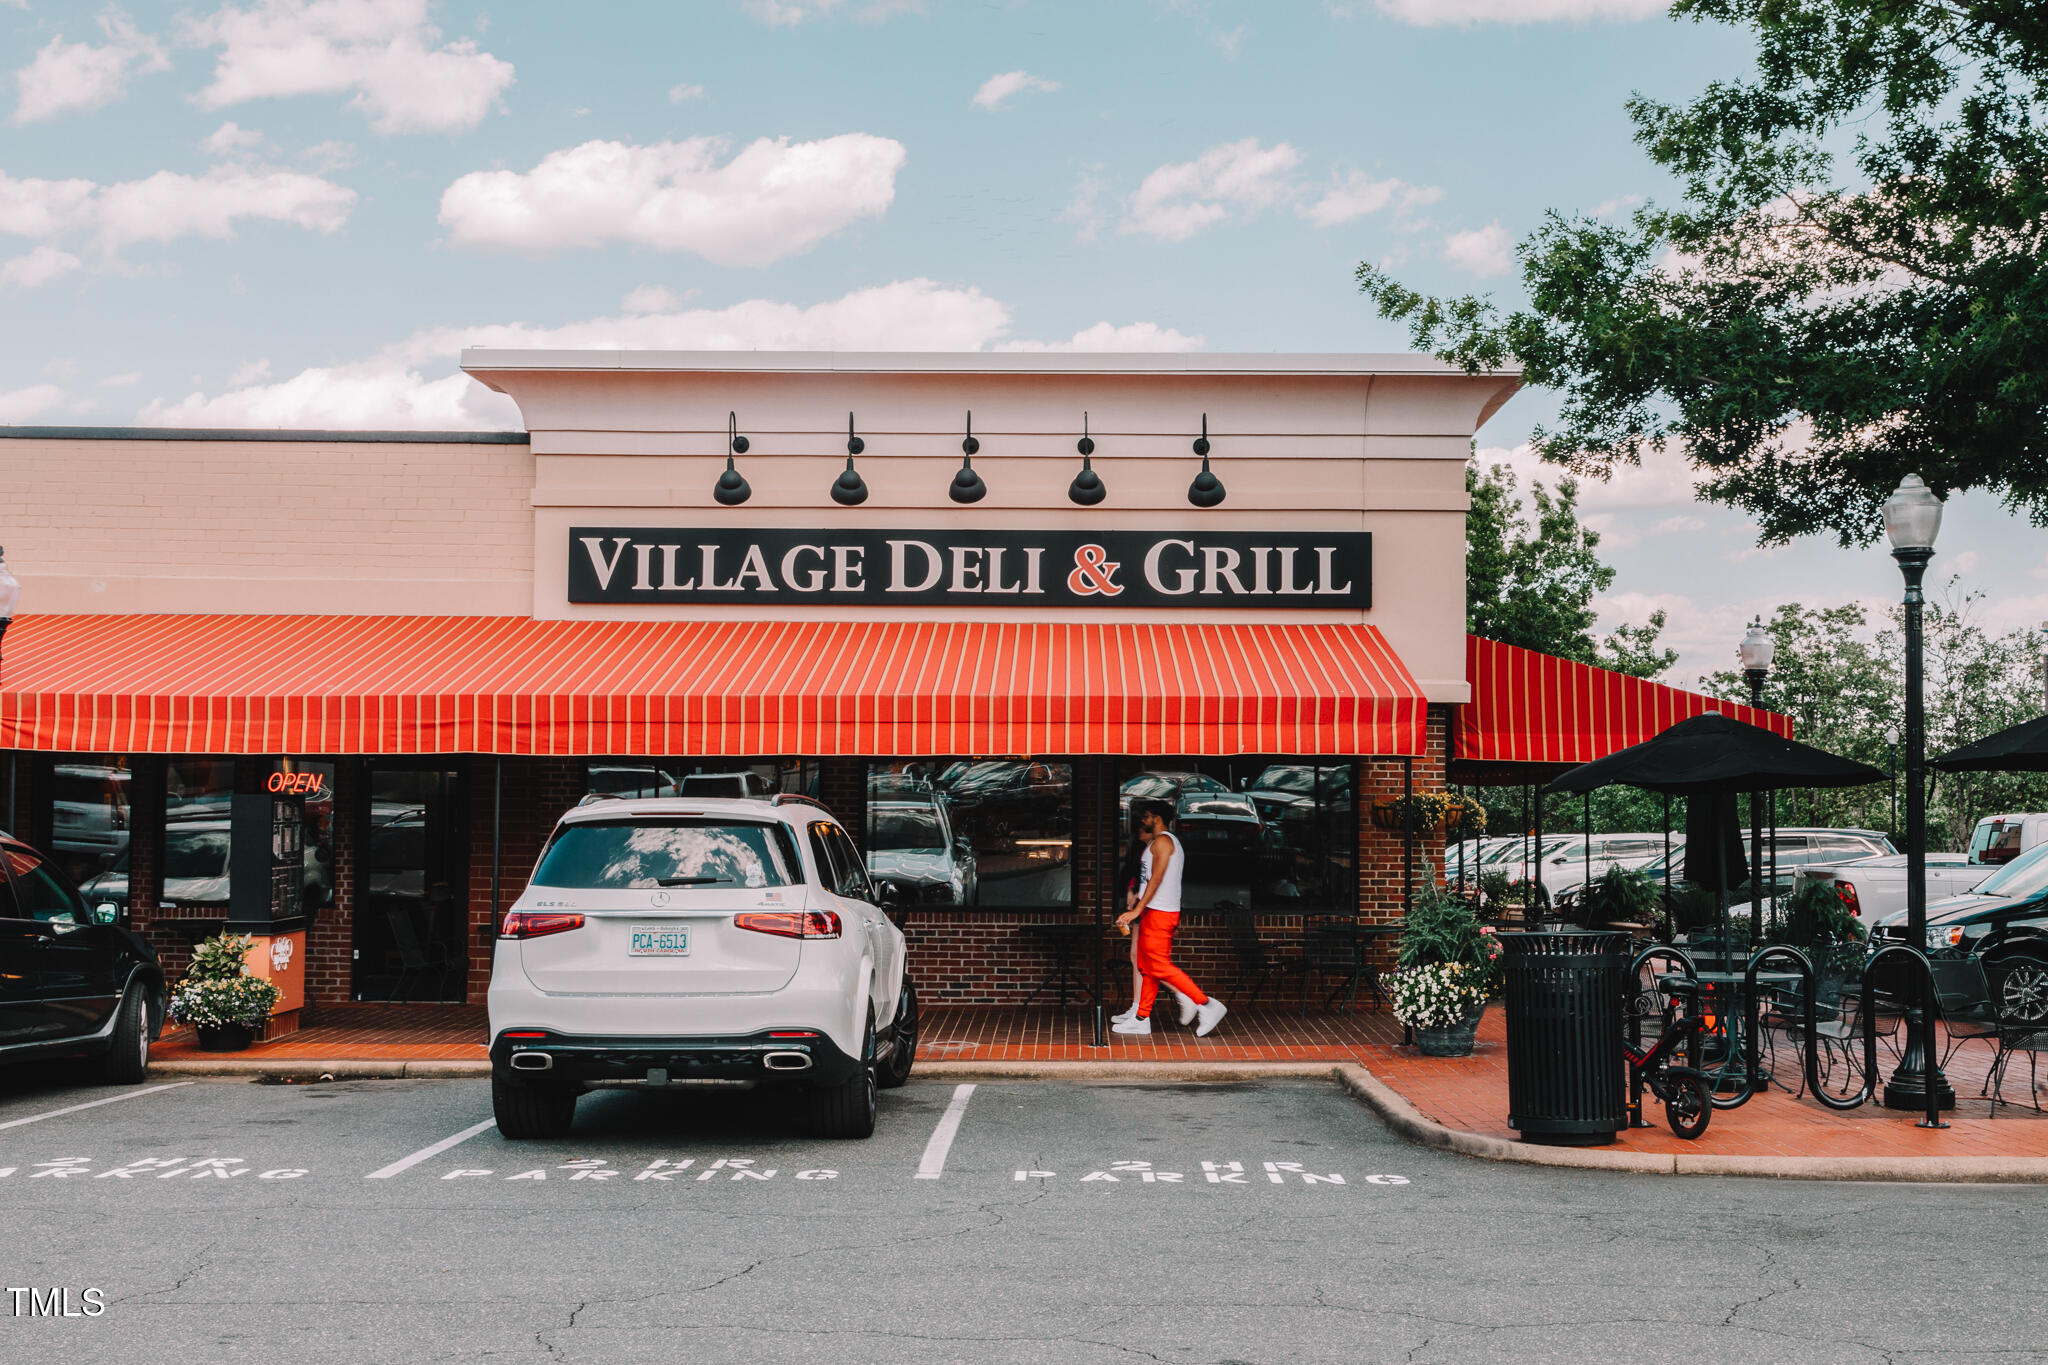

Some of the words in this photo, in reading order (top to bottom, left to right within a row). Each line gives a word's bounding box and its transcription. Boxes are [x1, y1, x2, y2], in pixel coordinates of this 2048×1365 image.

[579, 537, 865, 592] VILLAGE
[885, 540, 1046, 594] DELI
[1067, 543, 1125, 597] &
[1144, 539, 1352, 596] GRILL
[267, 772, 323, 793] OPEN
[632, 933, 687, 949] PCA-6513
[32, 1157, 92, 1167] 2
[126, 1157, 245, 1168] HR
[556, 1159, 609, 1169] 2
[647, 1159, 756, 1170] HR
[1110, 1160, 1153, 1171] 2
[1200, 1161, 1306, 1173] HR
[440, 1168, 840, 1181] PARKING
[1013, 1170, 1411, 1185] PARKING
